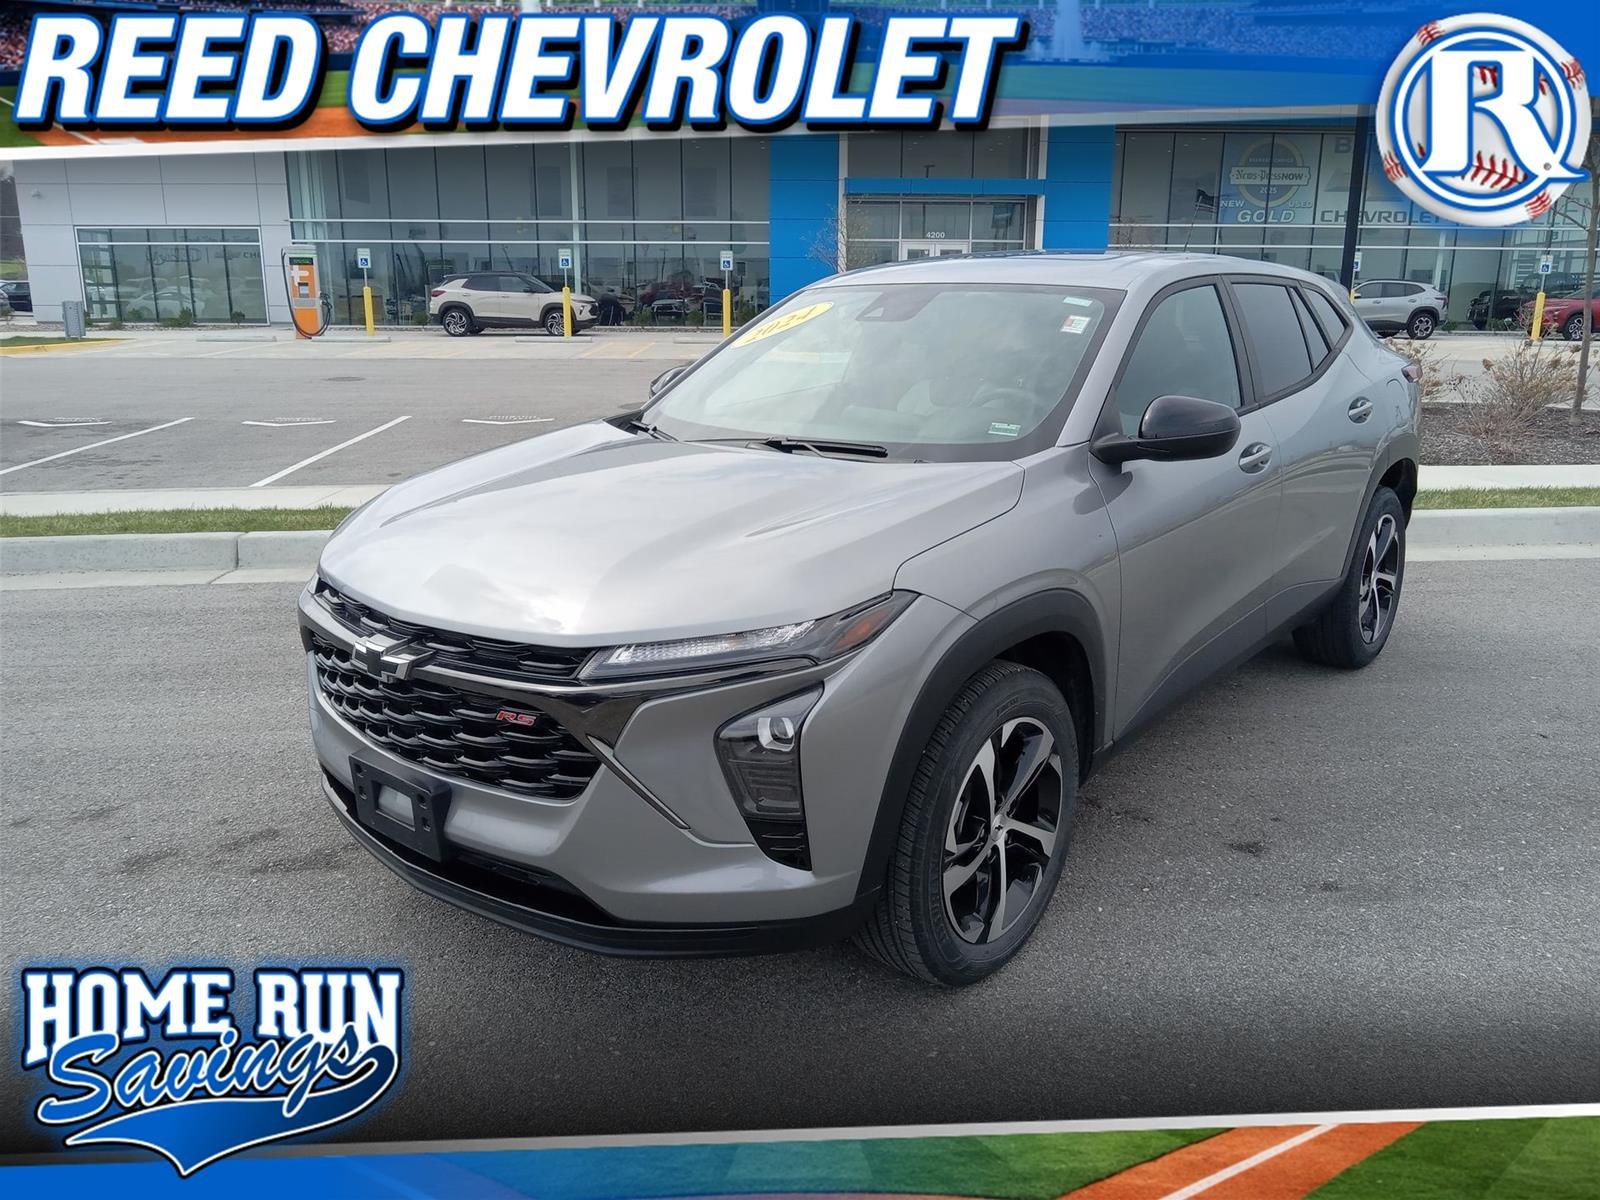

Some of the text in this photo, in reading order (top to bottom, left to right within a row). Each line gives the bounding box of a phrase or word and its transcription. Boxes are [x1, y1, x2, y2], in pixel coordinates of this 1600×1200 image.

[1237, 209, 1295, 223] GOLD
[1320, 210, 1440, 224] CHVROLE
[496, 710, 537, 726] RS
